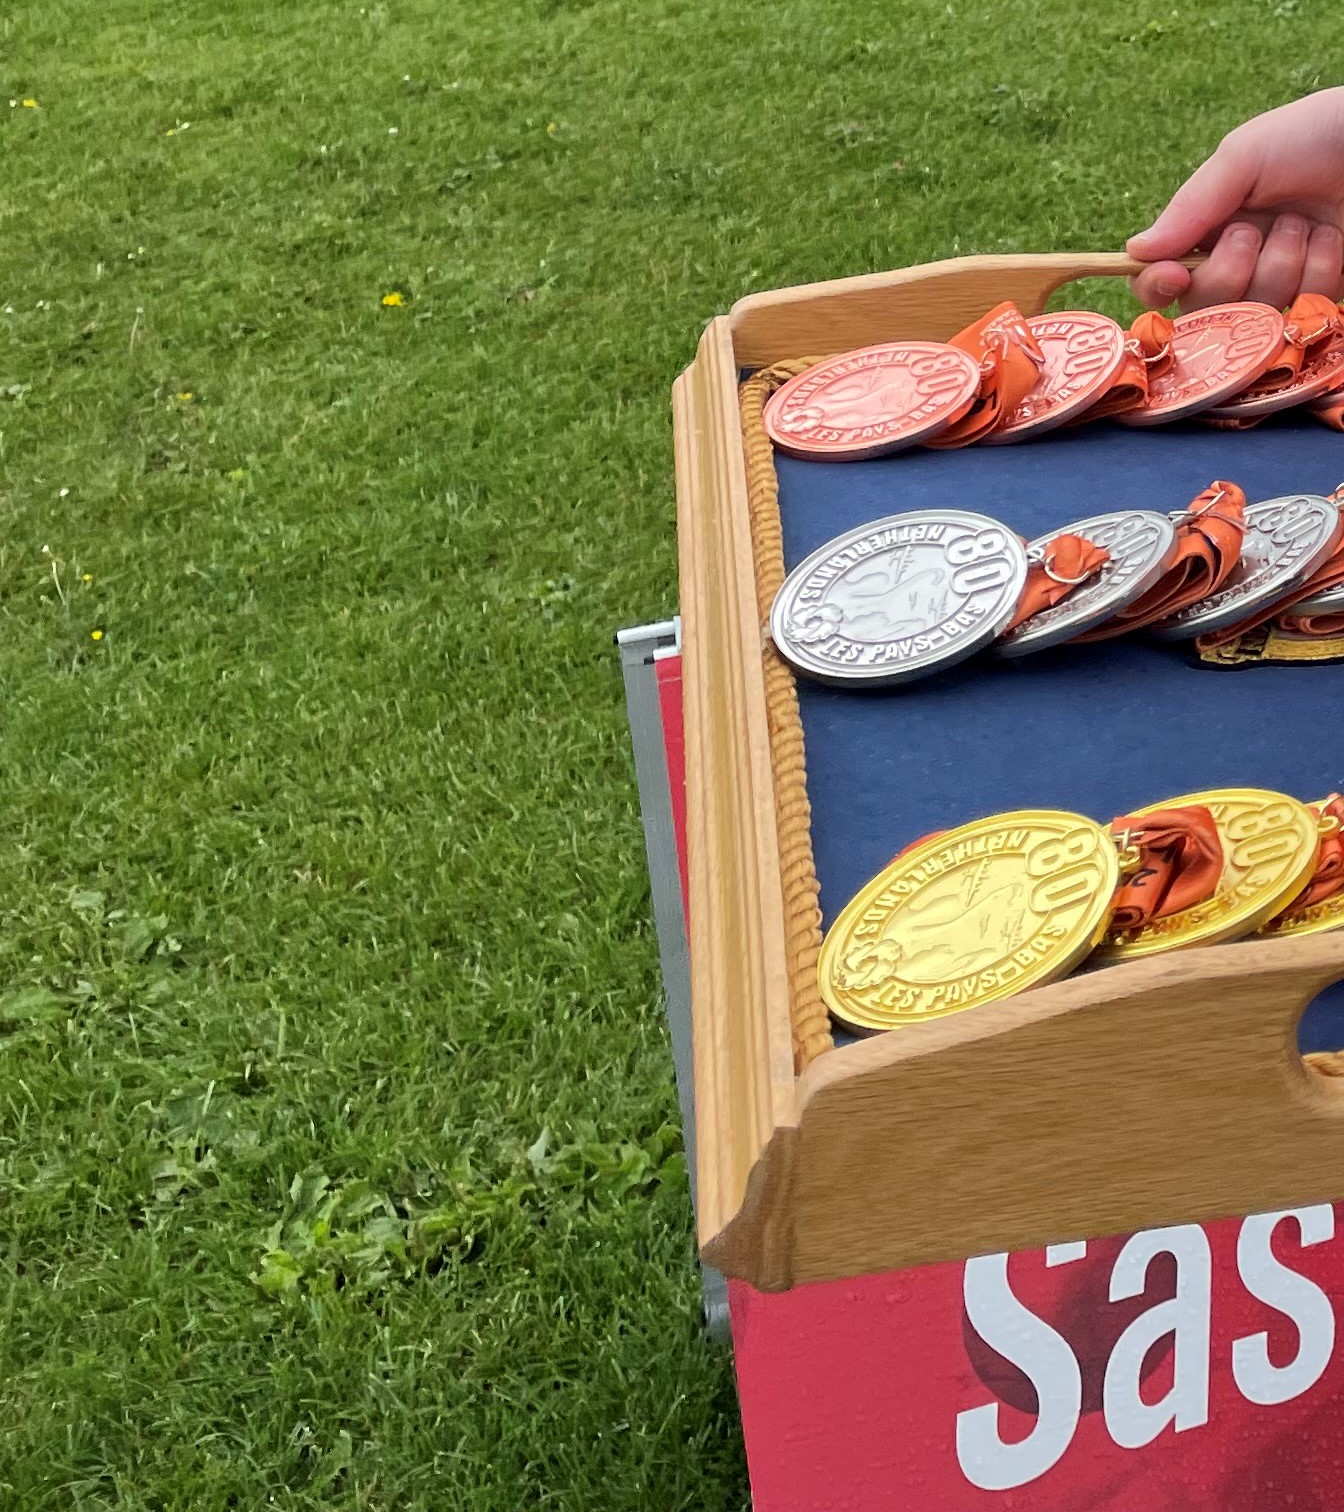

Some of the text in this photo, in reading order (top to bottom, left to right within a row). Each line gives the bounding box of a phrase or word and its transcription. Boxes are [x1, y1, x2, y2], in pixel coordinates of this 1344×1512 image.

[909, 351, 968, 395] 80
[1065, 324, 1115, 375] 80
[1092, 514, 1160, 560] 80
[1257, 498, 1326, 544] 80
[800, 524, 948, 601] NETHERLANDS
[945, 528, 1016, 595] 80
[818, 600, 987, 664] LES PAYS-BAS
[1224, 801, 1302, 869] 80
[854, 829, 1031, 937] NETHERLANDS
[1025, 827, 1102, 914] 80
[870, 923, 1068, 1010] LES PAYS-BAS
